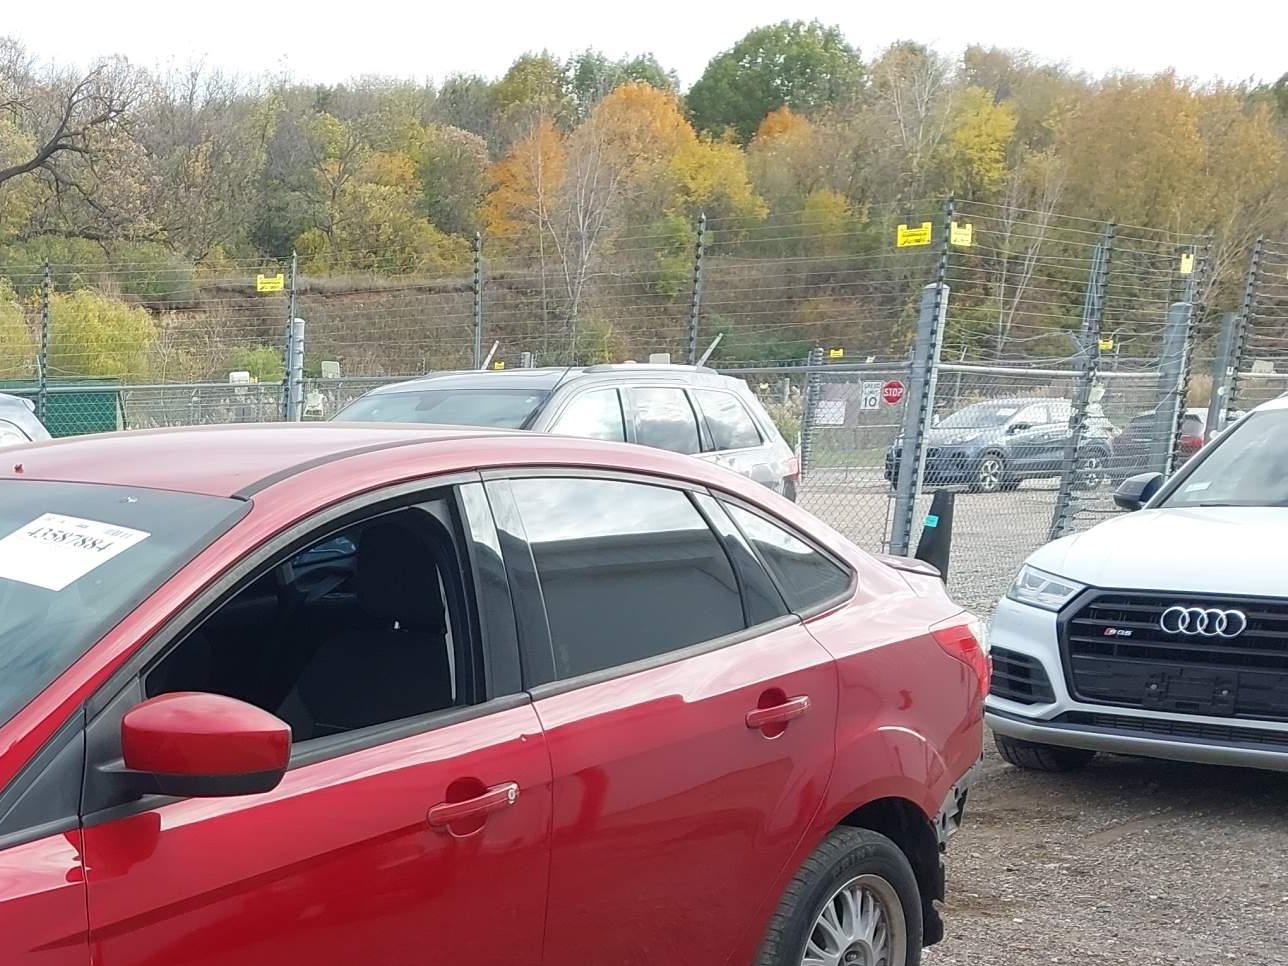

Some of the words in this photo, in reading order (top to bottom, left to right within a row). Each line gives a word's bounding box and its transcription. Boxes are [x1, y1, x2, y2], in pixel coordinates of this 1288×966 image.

[883, 387, 904, 397] STOP
[864, 396, 877, 408] 10
[27, 527, 115, 552] 43587884
